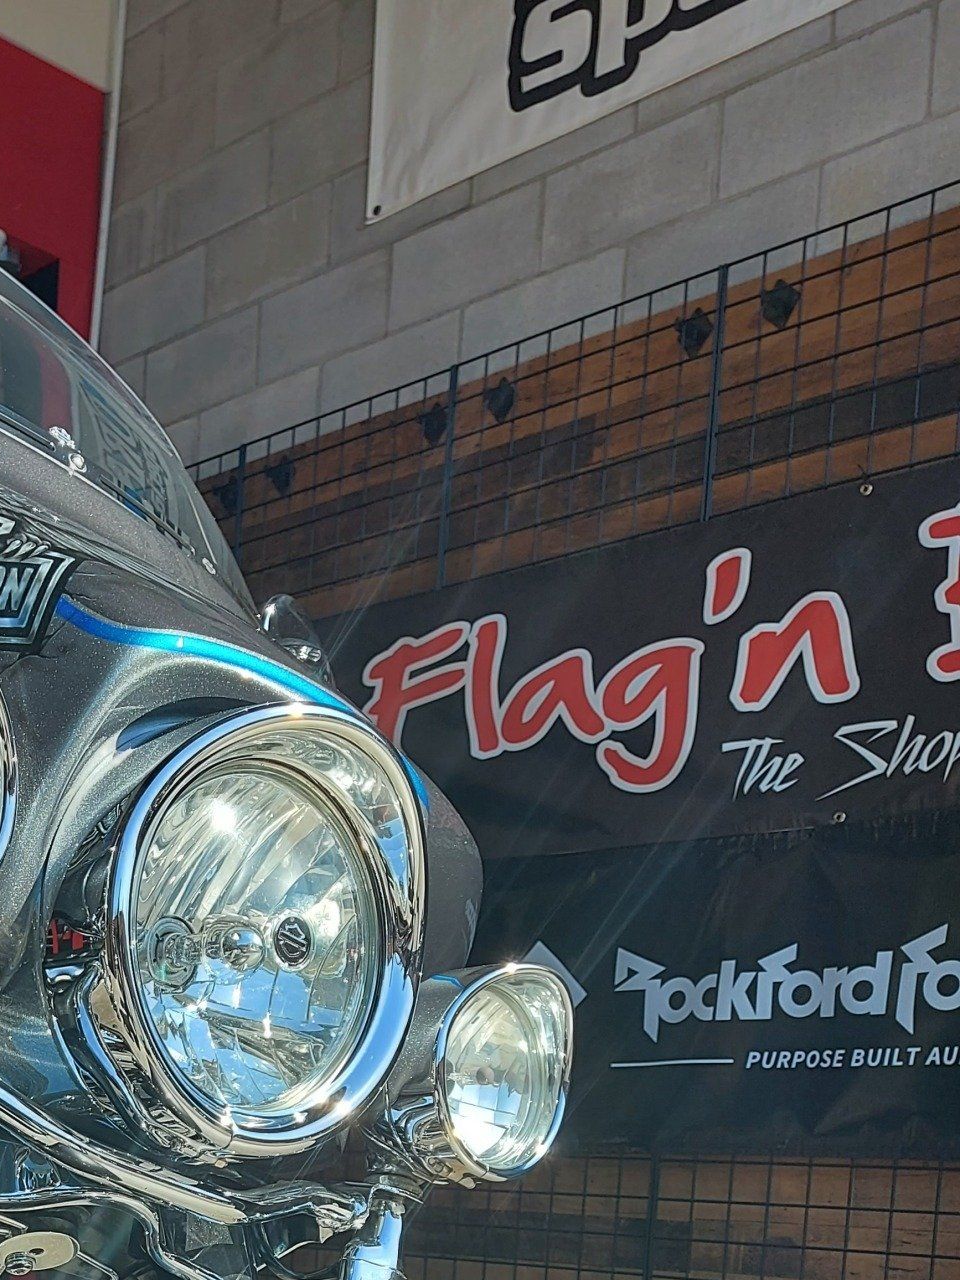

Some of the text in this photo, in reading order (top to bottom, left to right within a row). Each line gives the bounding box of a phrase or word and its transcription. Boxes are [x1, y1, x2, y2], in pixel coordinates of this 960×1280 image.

[721, 736, 804, 801] The
[614, 943, 893, 1043] Rockford
[745, 1046, 960, 1070] PURPOSE BUILT AU
